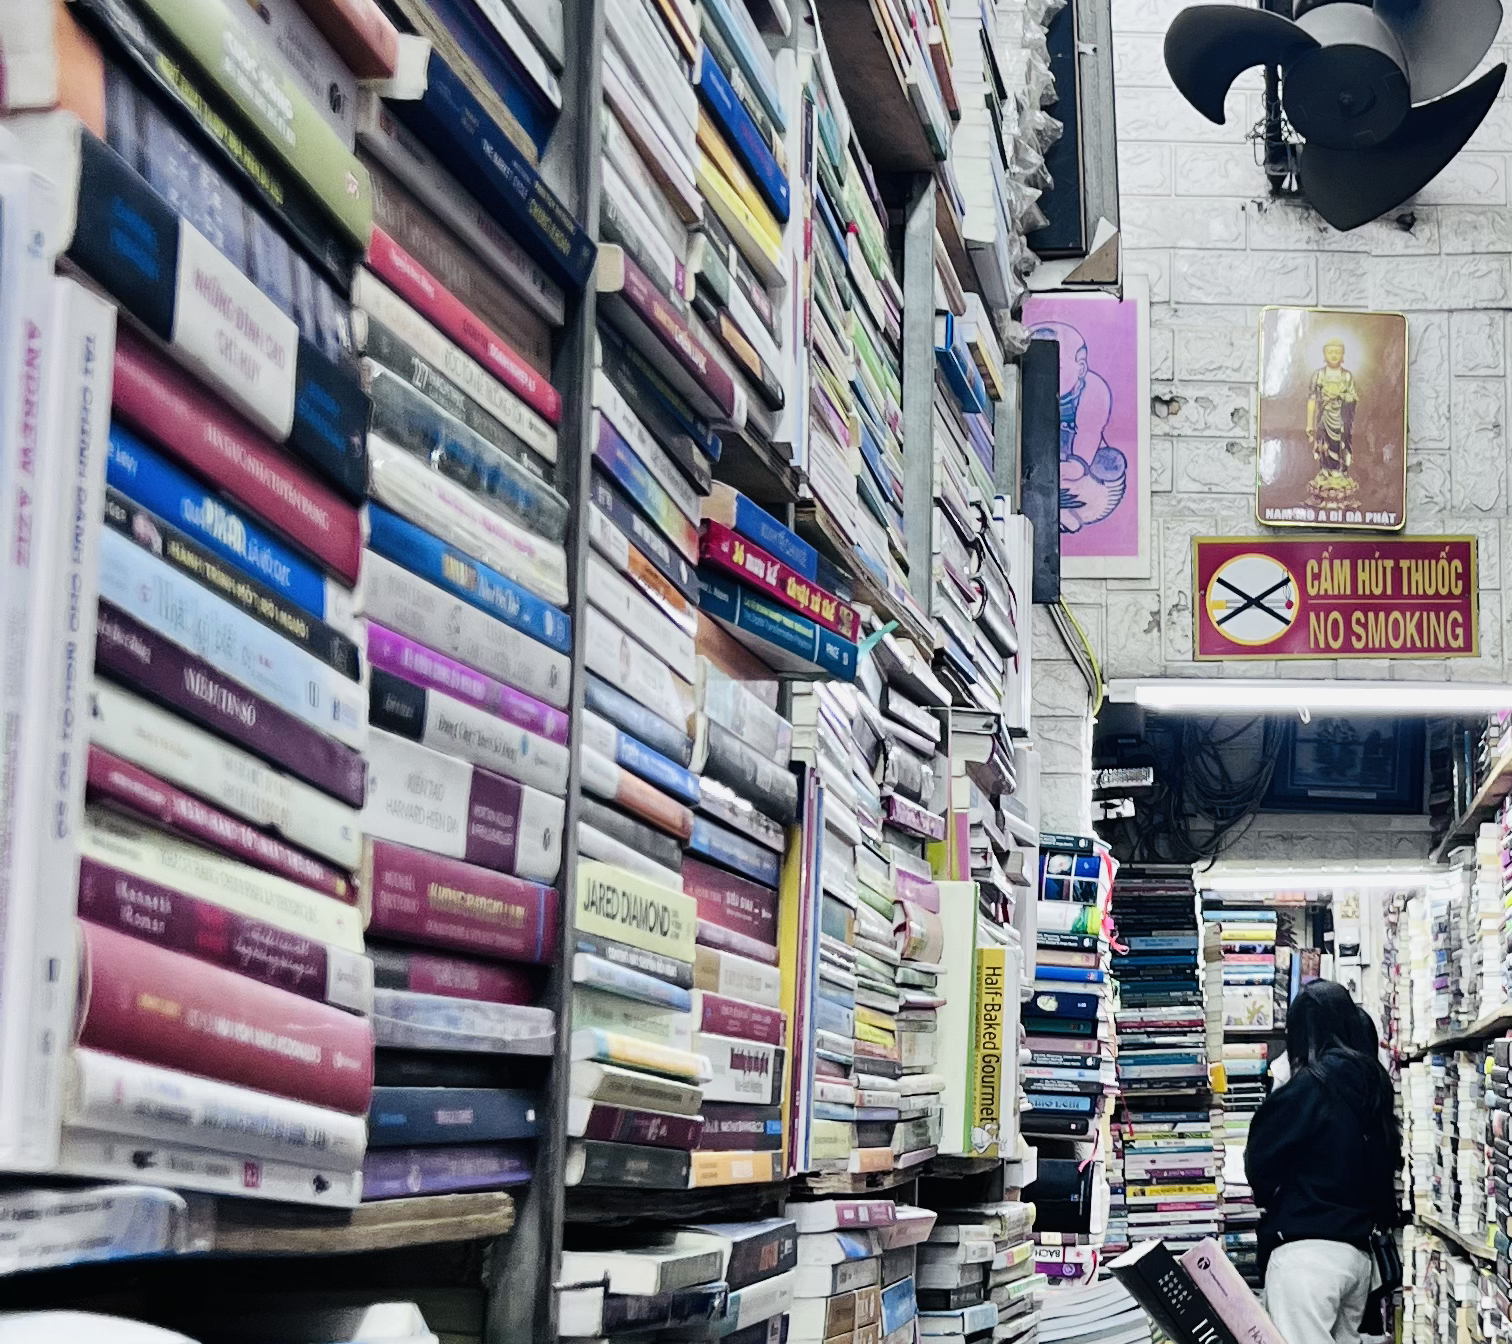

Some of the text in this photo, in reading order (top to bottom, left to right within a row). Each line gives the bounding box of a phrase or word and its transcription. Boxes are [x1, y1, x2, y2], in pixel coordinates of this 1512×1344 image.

[1318, 510, 1326, 521] A
[1306, 545, 1463, 596] CẤM HÚT THUỐC
[1308, 610, 1464, 649] NO SMOKING
[583, 871, 622, 919] JARED
[621, 882, 671, 935] DIAMOND
[979, 966, 1002, 1122] Half-Baked Gourmet
